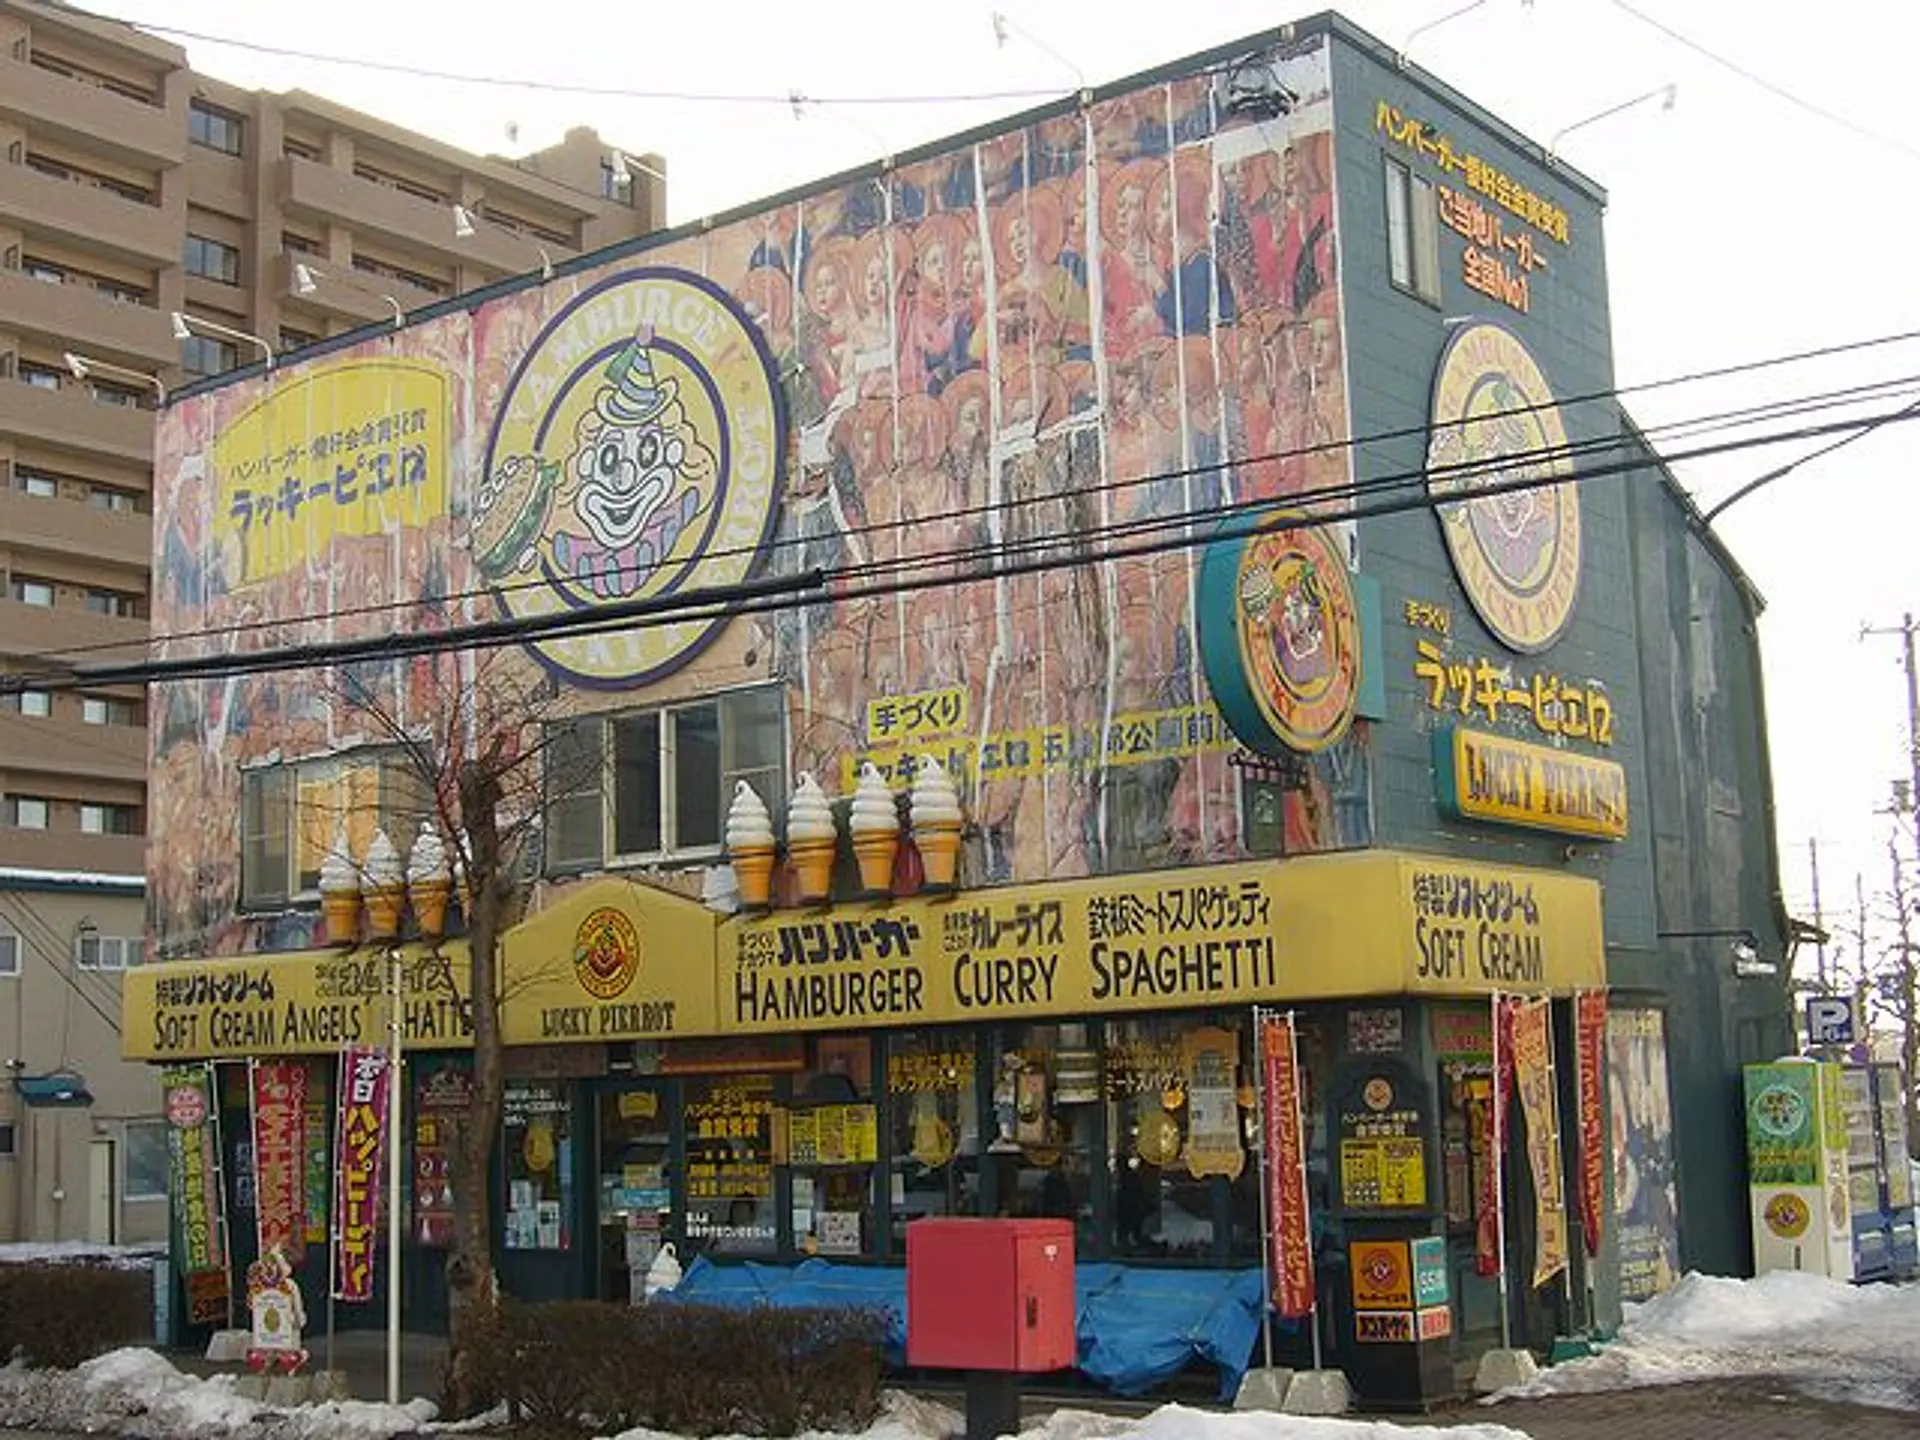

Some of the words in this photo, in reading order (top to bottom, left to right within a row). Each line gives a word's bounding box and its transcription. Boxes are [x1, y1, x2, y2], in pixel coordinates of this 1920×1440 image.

[228, 445, 428, 529] ラッキーピエロ
[875, 694, 962, 735] 手づくり
[1415, 639, 1613, 747] ラッキーピエロ
[971, 900, 1064, 950] カレーライス
[1088, 882, 1271, 941] 鉄板ミートスパゲッティ
[1810, 1001, 1850, 1040] P
